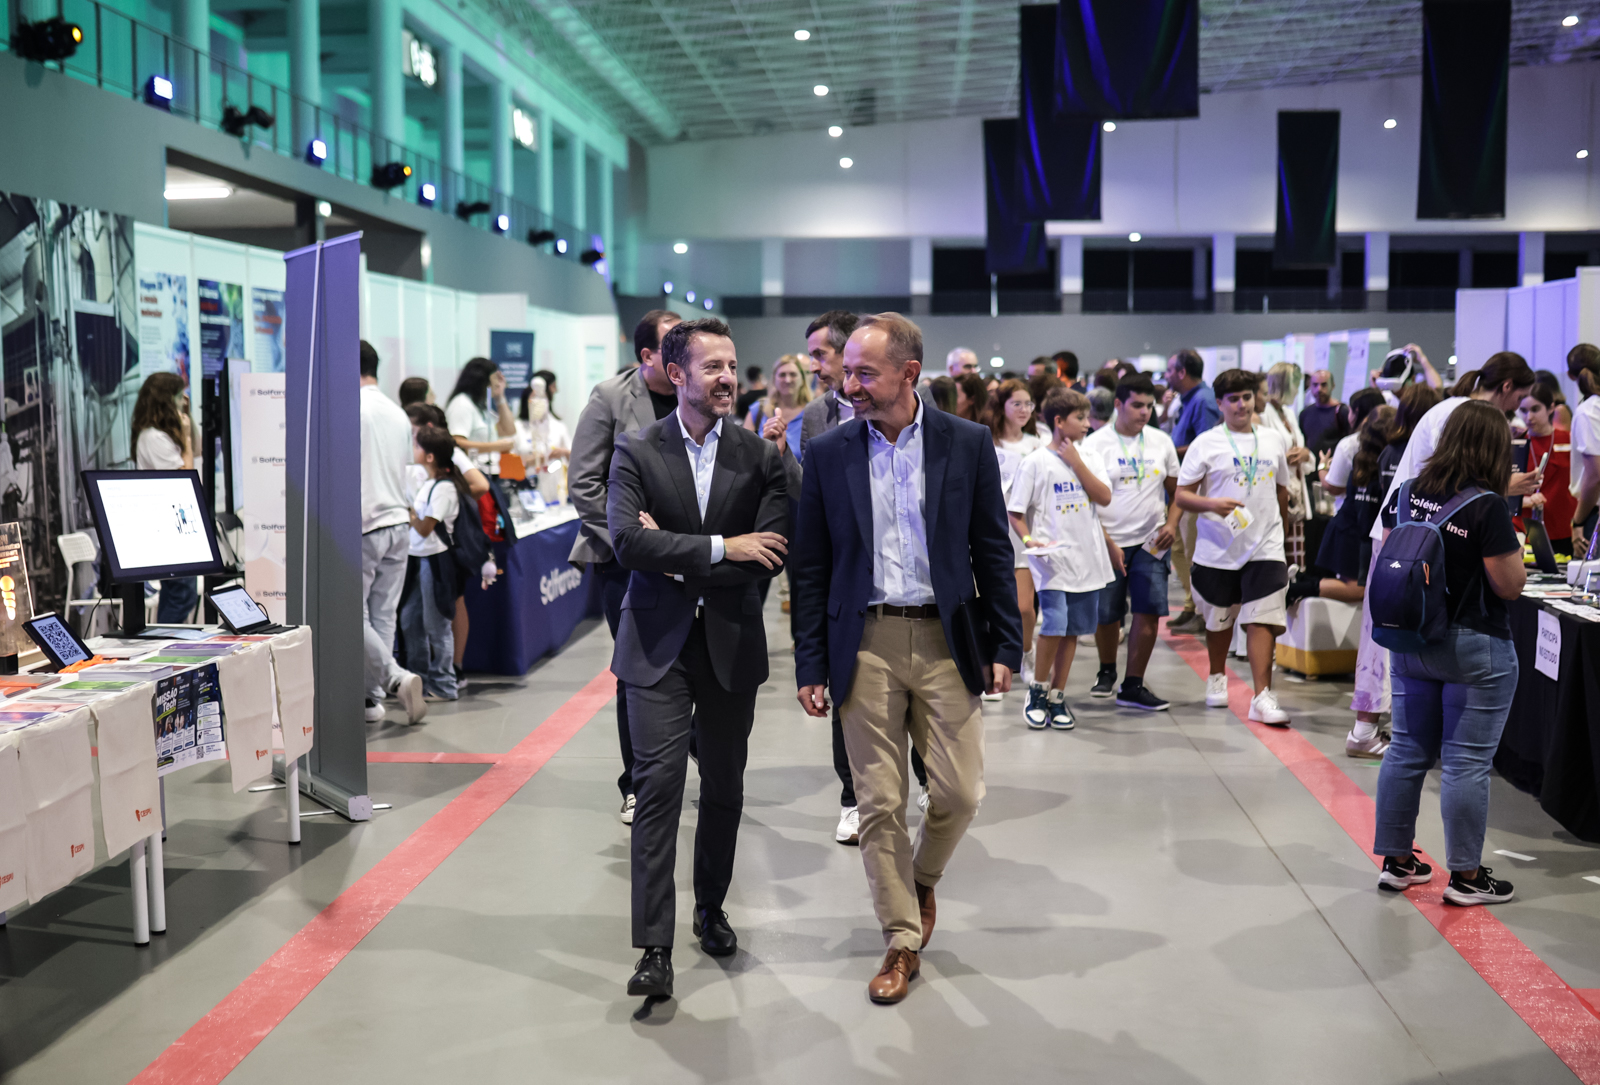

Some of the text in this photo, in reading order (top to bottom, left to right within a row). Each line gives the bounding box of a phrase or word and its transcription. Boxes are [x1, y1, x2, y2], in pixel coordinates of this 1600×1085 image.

[259, 456, 286, 464] Solfar
[1053, 481, 1075, 494] NEI
[1446, 521, 1468, 539] inci
[156, 687, 178, 707] MISSÃO
[163, 697, 177, 713] Tech
